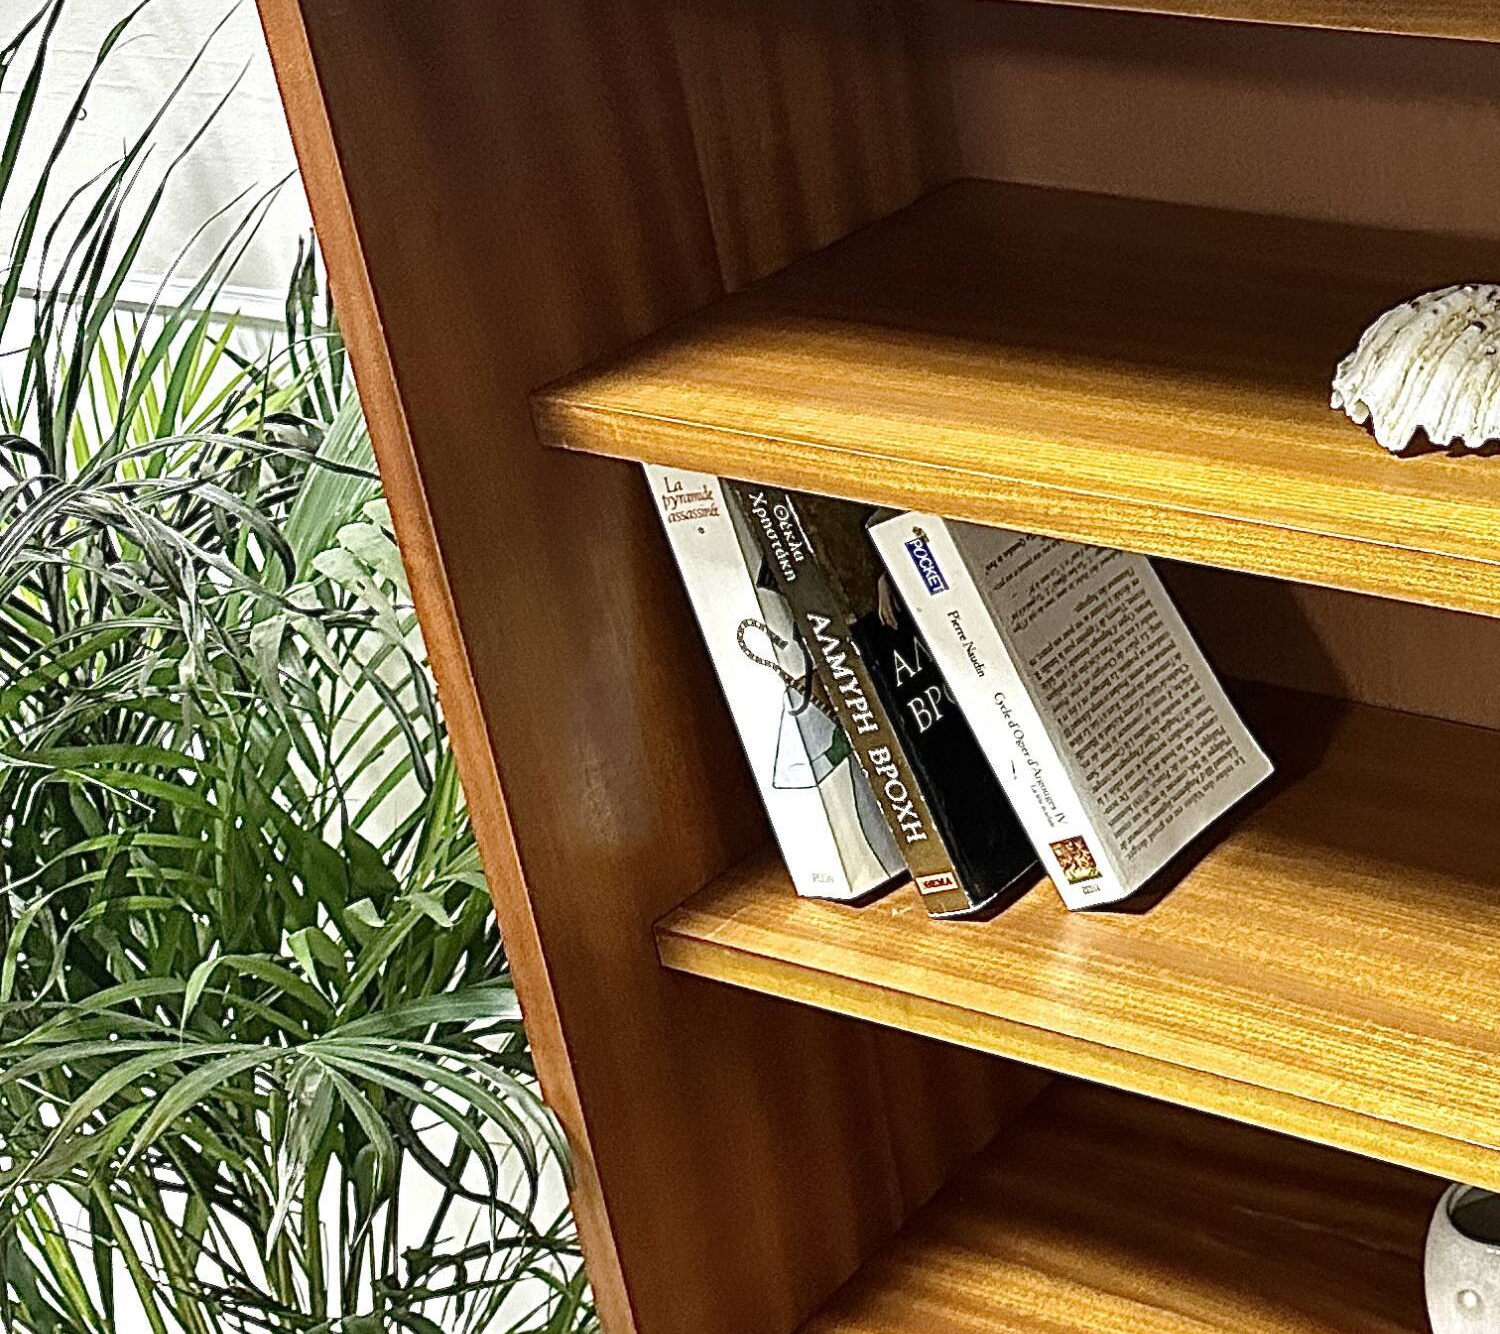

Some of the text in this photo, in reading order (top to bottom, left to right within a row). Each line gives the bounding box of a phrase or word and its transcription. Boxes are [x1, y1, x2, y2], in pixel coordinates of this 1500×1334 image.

[661, 485, 714, 511] pyramide
[664, 477, 683, 493] La
[773, 505, 805, 562] Θέκλα
[909, 537, 946, 594] POCKET
[947, 610, 985, 677] Pierre Naudin
[806, 612, 928, 844] ΑΛΜΥΡΗ ΒΡΟΧΗ
[994, 692, 1011, 720] Cycle
